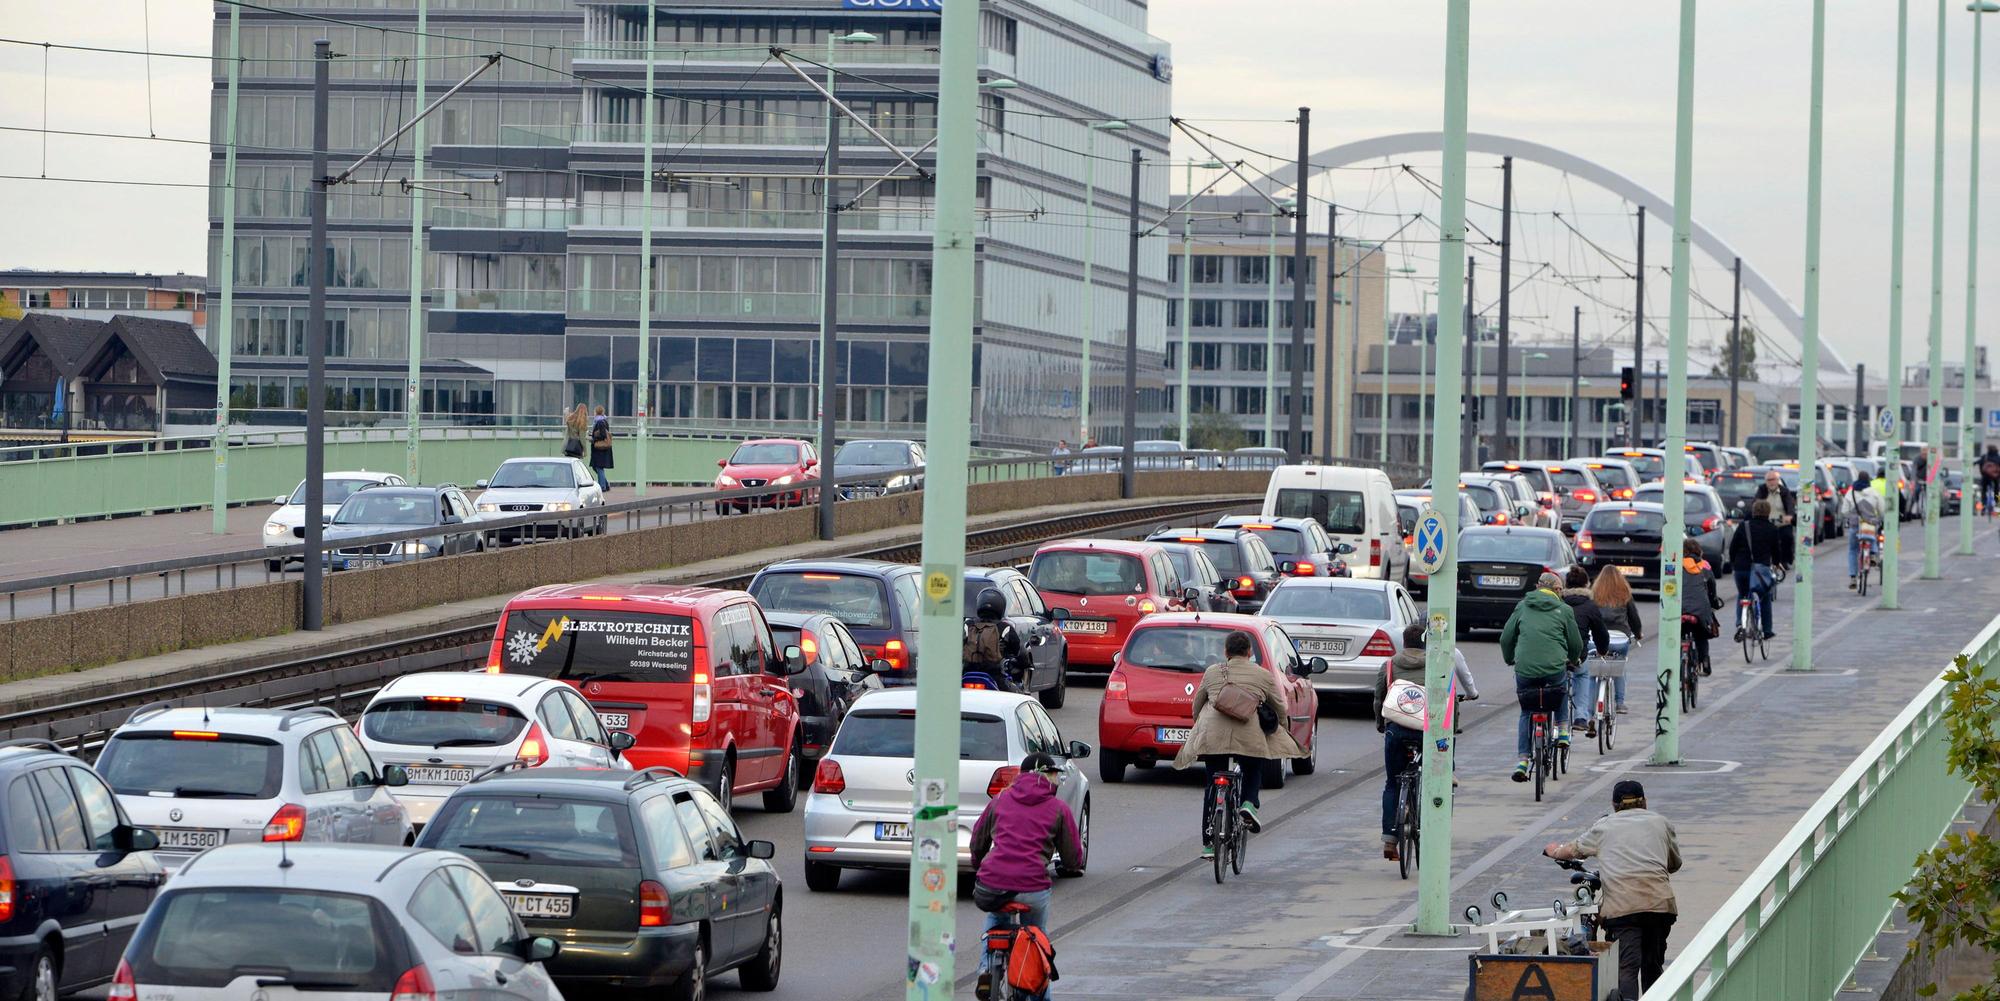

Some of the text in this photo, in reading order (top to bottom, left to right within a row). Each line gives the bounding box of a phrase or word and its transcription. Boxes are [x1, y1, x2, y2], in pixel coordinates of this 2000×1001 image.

[560, 620, 690, 636] ELEKTROTECHNIK
[1086, 622, 1106, 631] 1181
[605, 634, 689, 648] Wilhelm Becker
[1322, 642, 1344, 651] 1030
[638, 650, 678, 659] Kirchstraße
[630, 660, 688, 670] 50389 Wesseling
[606, 714, 628, 726] 533
[1164, 729, 1171, 740] K
[427, 769, 441, 781] KM
[444, 769, 470, 782] 1003
[883, 824, 898, 837] WI
[163, 831, 216, 847] IM 1580
[526, 897, 543, 912] CT
[546, 899, 570, 913] 455
[1511, 963, 1556, 1001] A
